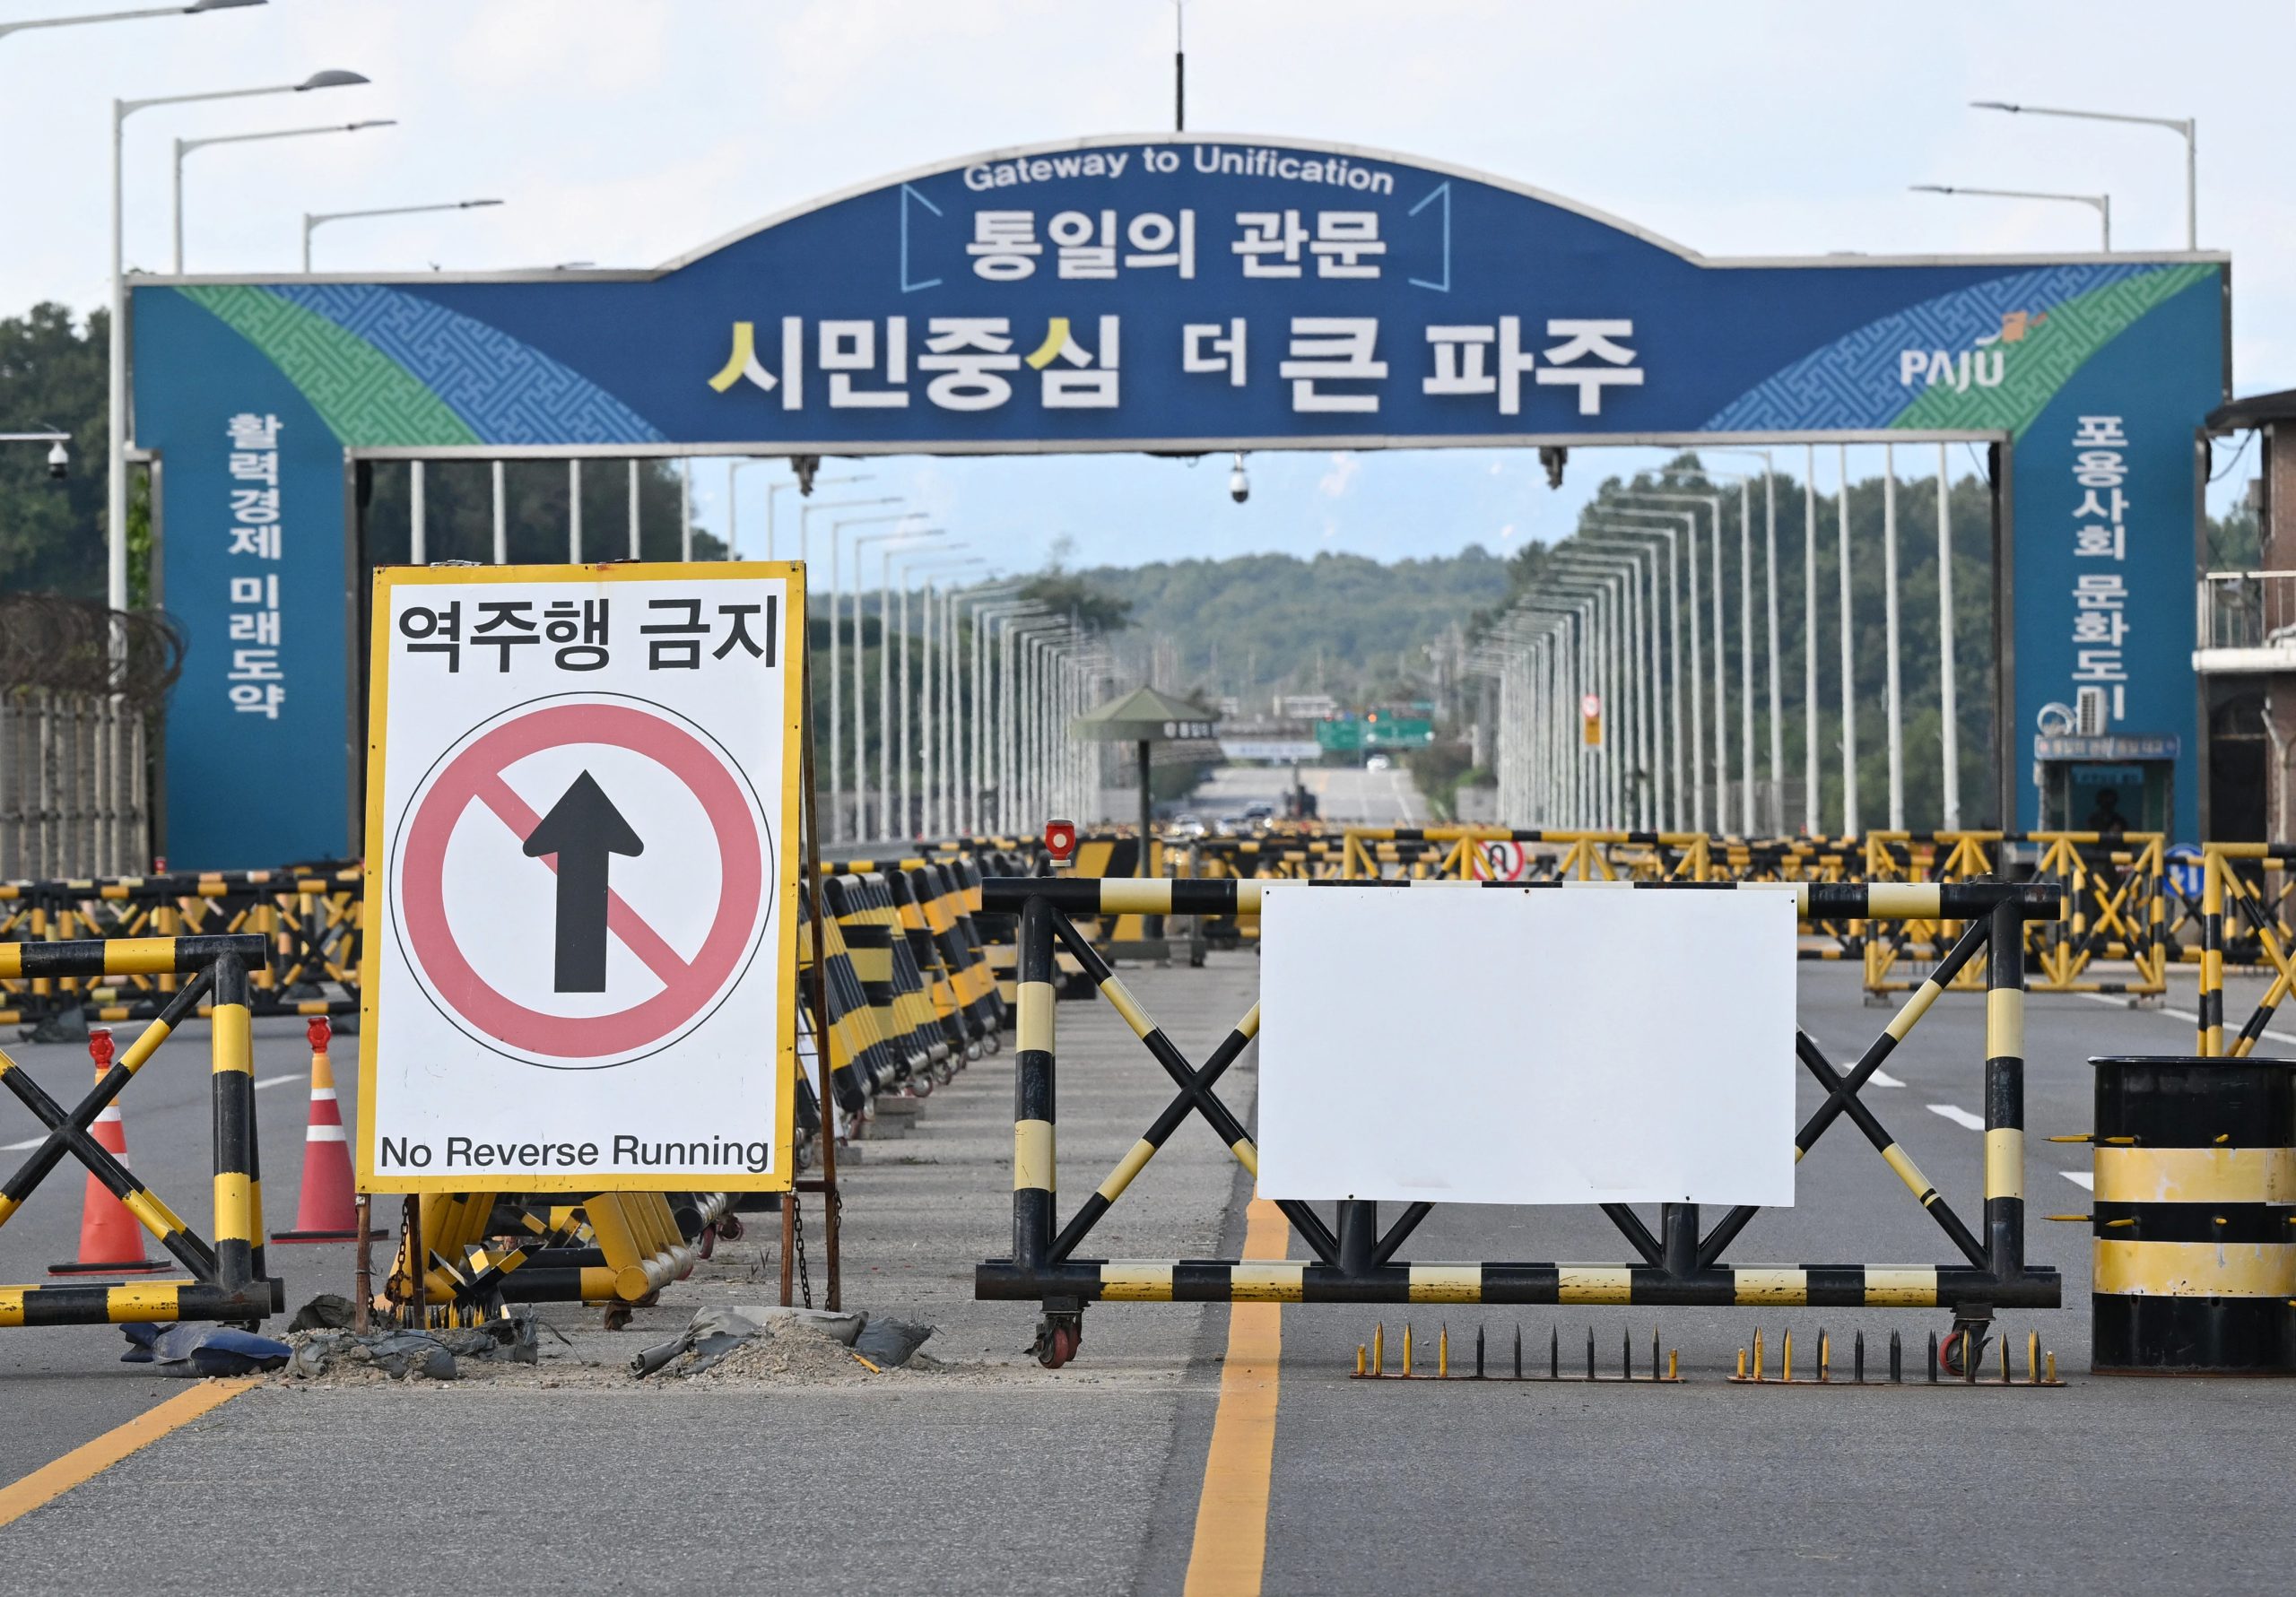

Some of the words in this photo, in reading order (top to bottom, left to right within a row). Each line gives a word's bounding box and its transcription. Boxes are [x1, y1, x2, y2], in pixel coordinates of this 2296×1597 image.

[963, 153, 1129, 191] Gateway
[1142, 146, 1180, 173] to
[1193, 144, 1395, 195] Unification
[965, 208, 1196, 282] 통일의
[1231, 208, 1387, 279] 관문
[708, 315, 1120, 412] 시민중심
[1183, 317, 1247, 386] 더
[1279, 317, 1388, 412] 큰
[1422, 315, 1645, 415] 파주
[1900, 349, 2005, 395] PAJU
[226, 413, 284, 560] 활력경제
[2071, 414, 2129, 560] 포용사회
[227, 573, 286, 719] 미래도약
[397, 597, 611, 674] 역주행
[639, 594, 778, 672] 금지
[380, 1135, 433, 1168] No
[446, 1135, 600, 1168] Reverse
[612, 1134, 770, 1174] Running
